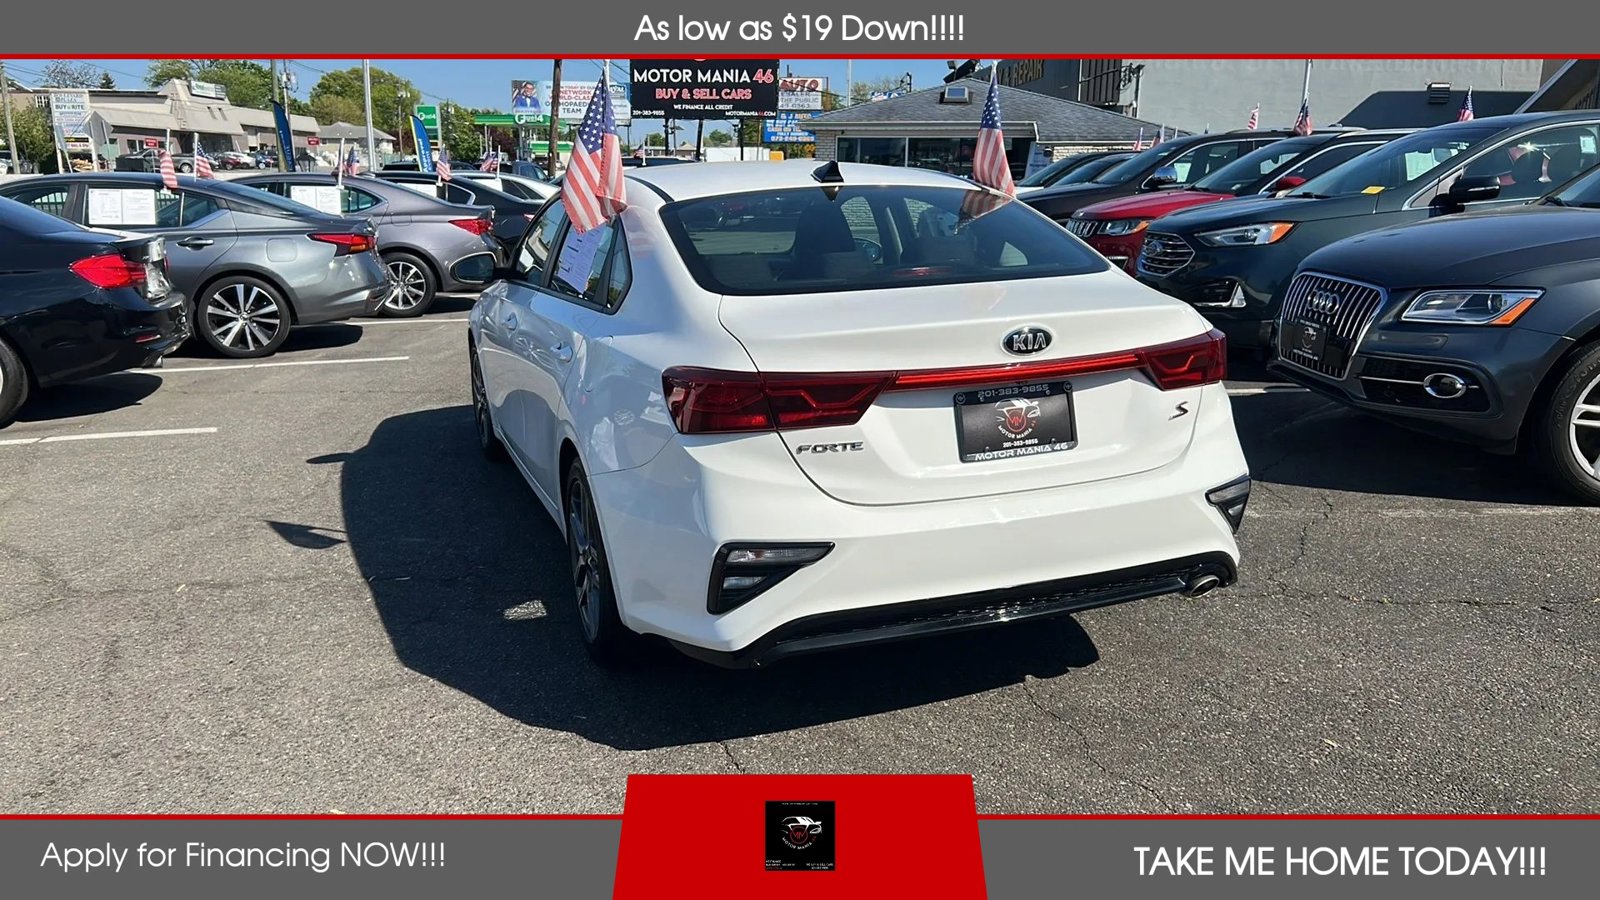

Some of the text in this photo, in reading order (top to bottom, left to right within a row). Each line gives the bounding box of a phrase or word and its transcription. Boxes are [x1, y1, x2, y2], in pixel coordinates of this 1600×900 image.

[633, 68, 774, 84] MOTOR MANIA 46
[655, 88, 753, 99] BUY & SELL CARS
[1013, 333, 1046, 350] KIA
[978, 384, 1049, 399] 201-383-9855
[1168, 401, 1188, 421] S
[998, 425, 1016, 439] MOTOR
[1016, 427, 1033, 439] MANIA
[796, 442, 864, 455] FORTE
[975, 442, 1069, 461] MOTOR MANIA 46
